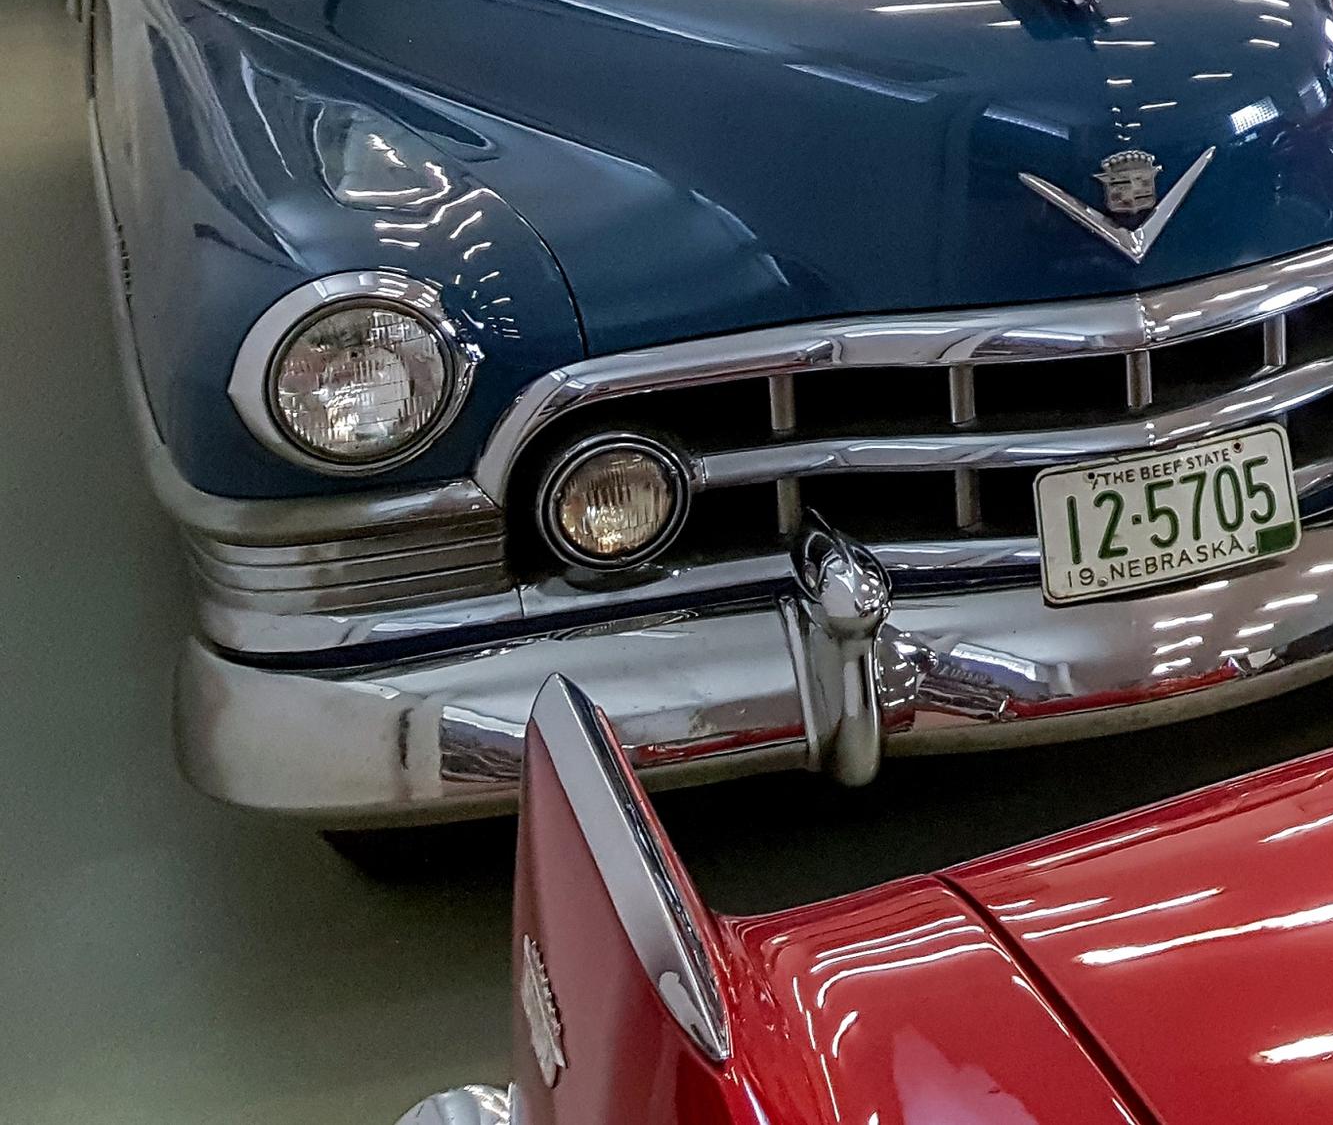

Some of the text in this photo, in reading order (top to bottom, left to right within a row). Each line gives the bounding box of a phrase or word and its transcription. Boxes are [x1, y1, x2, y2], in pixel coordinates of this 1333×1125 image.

[1103, 447, 1231, 486] THE BEEF STATE
[1066, 535, 1245, 589] 19 NEBRASKA
